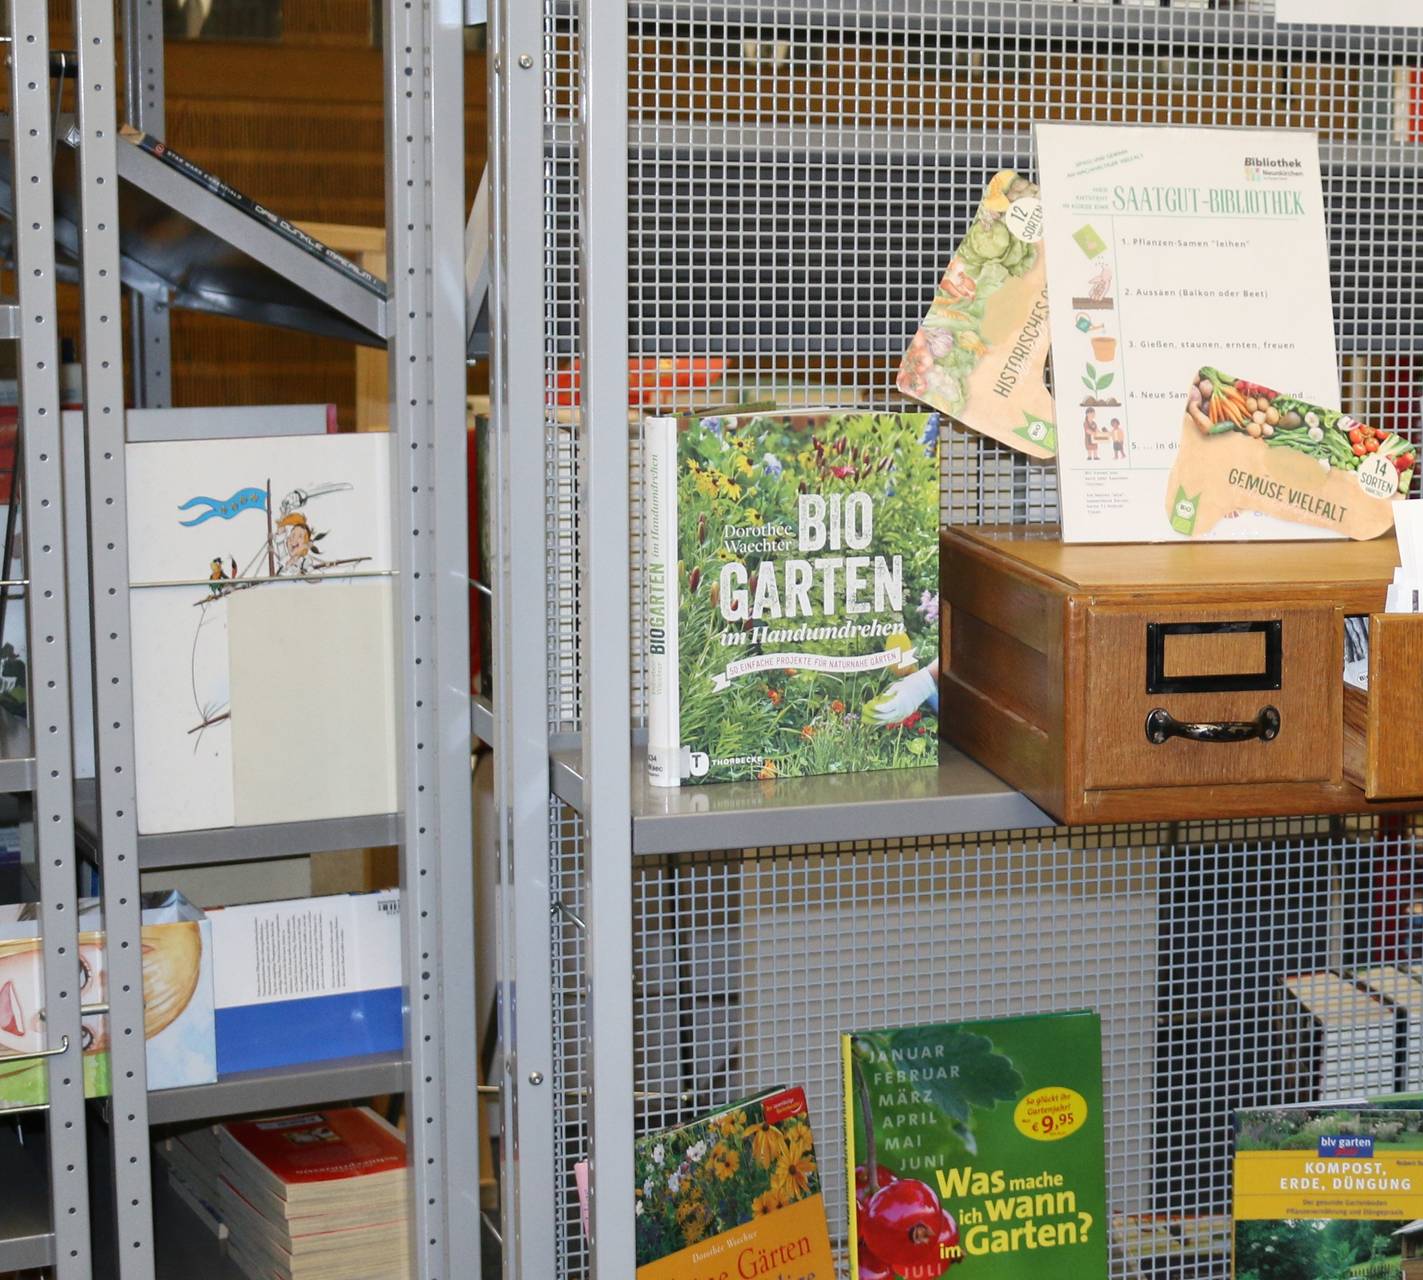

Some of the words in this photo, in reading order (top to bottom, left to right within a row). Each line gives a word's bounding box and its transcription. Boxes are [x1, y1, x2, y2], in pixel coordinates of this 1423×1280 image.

[1244, 156, 1303, 168] Bibliothek
[1113, 185, 1304, 215] SAATGUT-BIBLIOTHEK
[1010, 205, 1028, 222] 12
[1022, 204, 1044, 240] SORTEN
[255, 205, 278, 222] DAS
[280, 220, 324, 251] DUNKLE
[325, 249, 372, 281] IMPERIUM
[1121, 238, 1130, 246] 1.
[1133, 238, 1209, 248] Pflanzen-Samen
[1124, 288, 1133, 296] 2.
[1178, 288, 1215, 298] (Balkon
[1218, 289, 1239, 297] oder
[1243, 289, 1269, 298] Beet)
[993, 301, 1050, 398] HISTORISCHES
[1128, 341, 1137, 349] 3.
[1140, 340, 1178, 349] Gießen,
[1181, 341, 1222, 350] staunen,
[1225, 342, 1261, 351] ernten,
[1263, 341, 1296, 350] freuen
[1129, 391, 1138, 399] 4.
[1141, 391, 1167, 400] Neue
[1168, 391, 1188, 400] Sam
[1131, 442, 1140, 450] 5.
[1156, 442, 1165, 450] in
[1375, 459, 1387, 476] 14
[1360, 472, 1394, 494] SORTEN
[650, 453, 661, 541] Handumdrehen
[1228, 468, 1286, 502] GEMÜSE
[1288, 488, 1348, 523] VIELFALT
[723, 522, 793, 538] Dorothee
[798, 491, 874, 551] BIO
[651, 541, 661, 558] im
[723, 537, 793, 554] Waechter
[719, 555, 903, 621] GARTEN
[649, 562, 666, 655] BIOGARTEN
[720, 628, 747, 646] im
[751, 619, 906, 645] Handumdrehen
[740, 657, 773, 671] EINFACHE
[776, 657, 811, 665] PROJEKTE
[829, 659, 869, 669] NATURNAHE
[870, 653, 897, 666] GÄRTEN
[711, 755, 763, 767] THORBECKE
[868, 1044, 945, 1065] JANUAR
[874, 1065, 961, 1086] FEBRUAR
[878, 1089, 933, 1107] MÄRZ
[882, 1112, 937, 1129] APRIL
[1031, 1122, 1040, 1132] €
[1041, 1113, 1075, 1134] 9,95
[885, 1135, 922, 1150] MAI
[1320, 1137, 1337, 1147] blv
[1338, 1137, 1371, 1149] garten
[900, 1154, 945, 1171] JUNI
[1305, 1161, 1387, 1176] KOMPOST,
[936, 1167, 1005, 1199] Was
[1009, 1171, 1064, 1191] mache
[1279, 1177, 1326, 1191] ERDE,
[1332, 1174, 1412, 1191] DÜNGUNG
[959, 1208, 983, 1225] ich
[984, 1189, 1077, 1222] wann
[939, 1243, 963, 1260] im
[964, 1212, 1094, 1256] Garten?
[737, 1235, 813, 1280] Gärten
[903, 1264, 943, 1280] JULI
